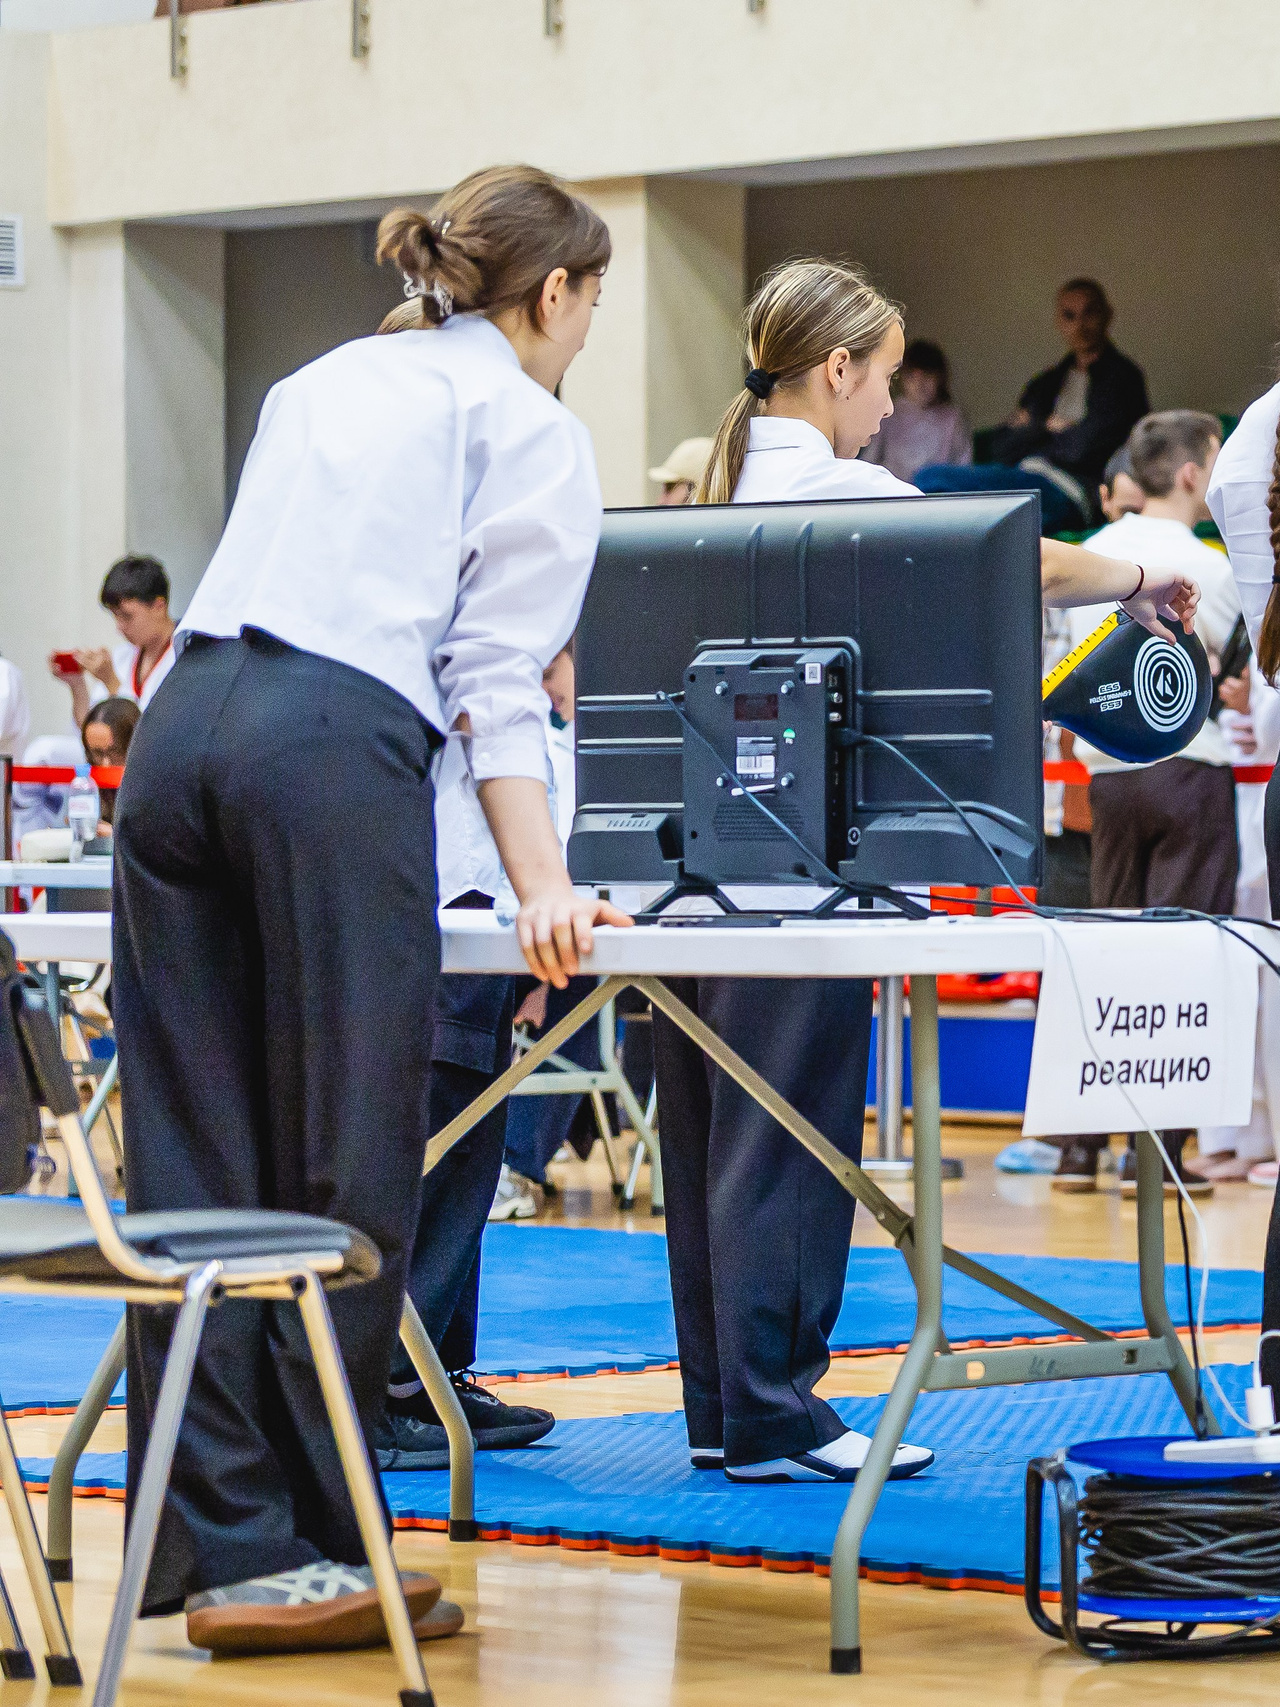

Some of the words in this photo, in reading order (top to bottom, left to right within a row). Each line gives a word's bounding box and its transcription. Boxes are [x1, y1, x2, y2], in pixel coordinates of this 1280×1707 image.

[1098, 681, 1121, 695] ESS
[1095, 996, 1166, 1038] Удар
[1177, 1001, 1208, 1028] на
[1079, 1056, 1211, 1095] реакцию
